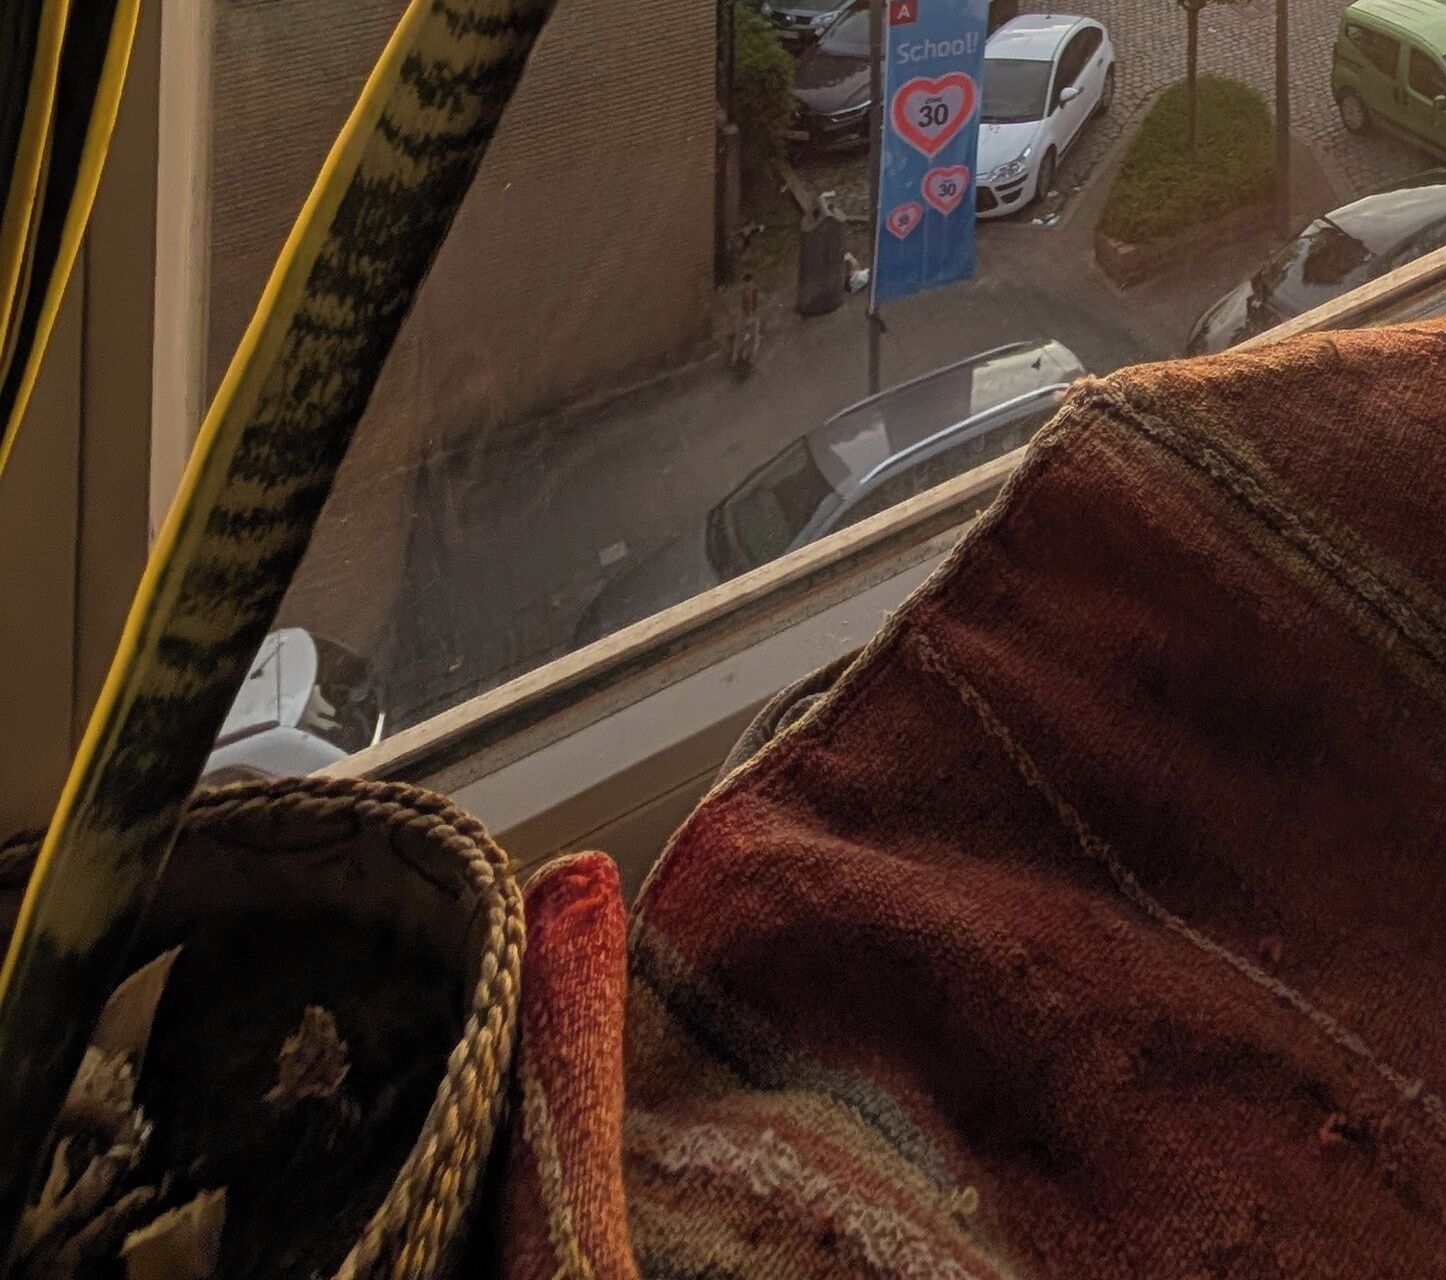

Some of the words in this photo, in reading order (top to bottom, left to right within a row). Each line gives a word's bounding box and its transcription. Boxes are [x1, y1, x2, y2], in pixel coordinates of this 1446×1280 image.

[897, 4, 910, 19] A
[897, 32, 979, 64] School!
[918, 104, 949, 128] 30
[938, 183, 957, 197] 30
